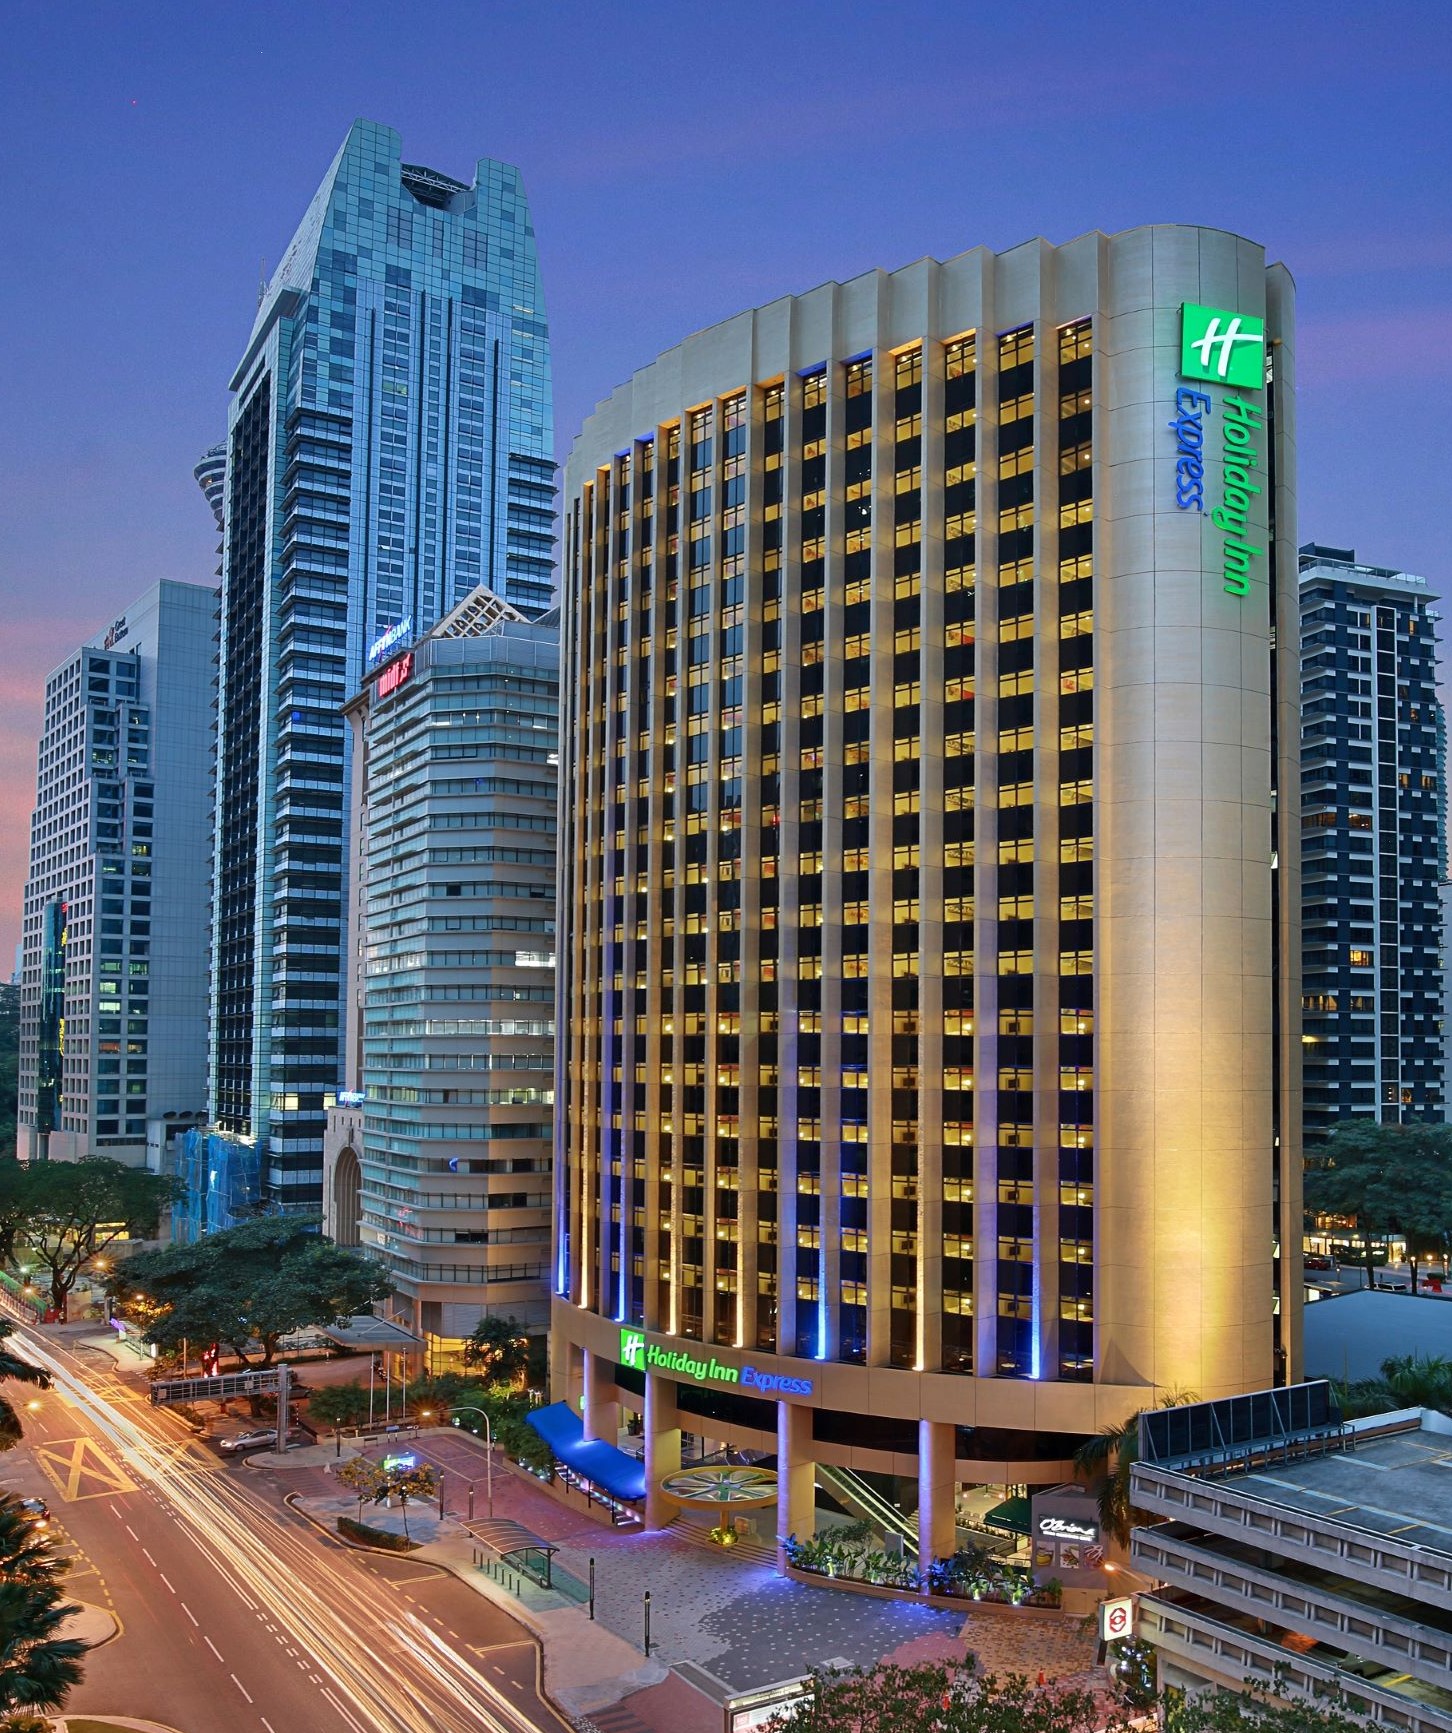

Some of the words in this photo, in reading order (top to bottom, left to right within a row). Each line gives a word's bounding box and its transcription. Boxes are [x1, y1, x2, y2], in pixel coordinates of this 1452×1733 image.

[1168, 387, 1211, 512] Express
[1211, 395, 1262, 537] Holiday
[1223, 538, 1264, 597] Inn
[647, 1344, 707, 1380] Holiday
[709, 1358, 738, 1383] Inn
[741, 1366, 813, 1395] Express
